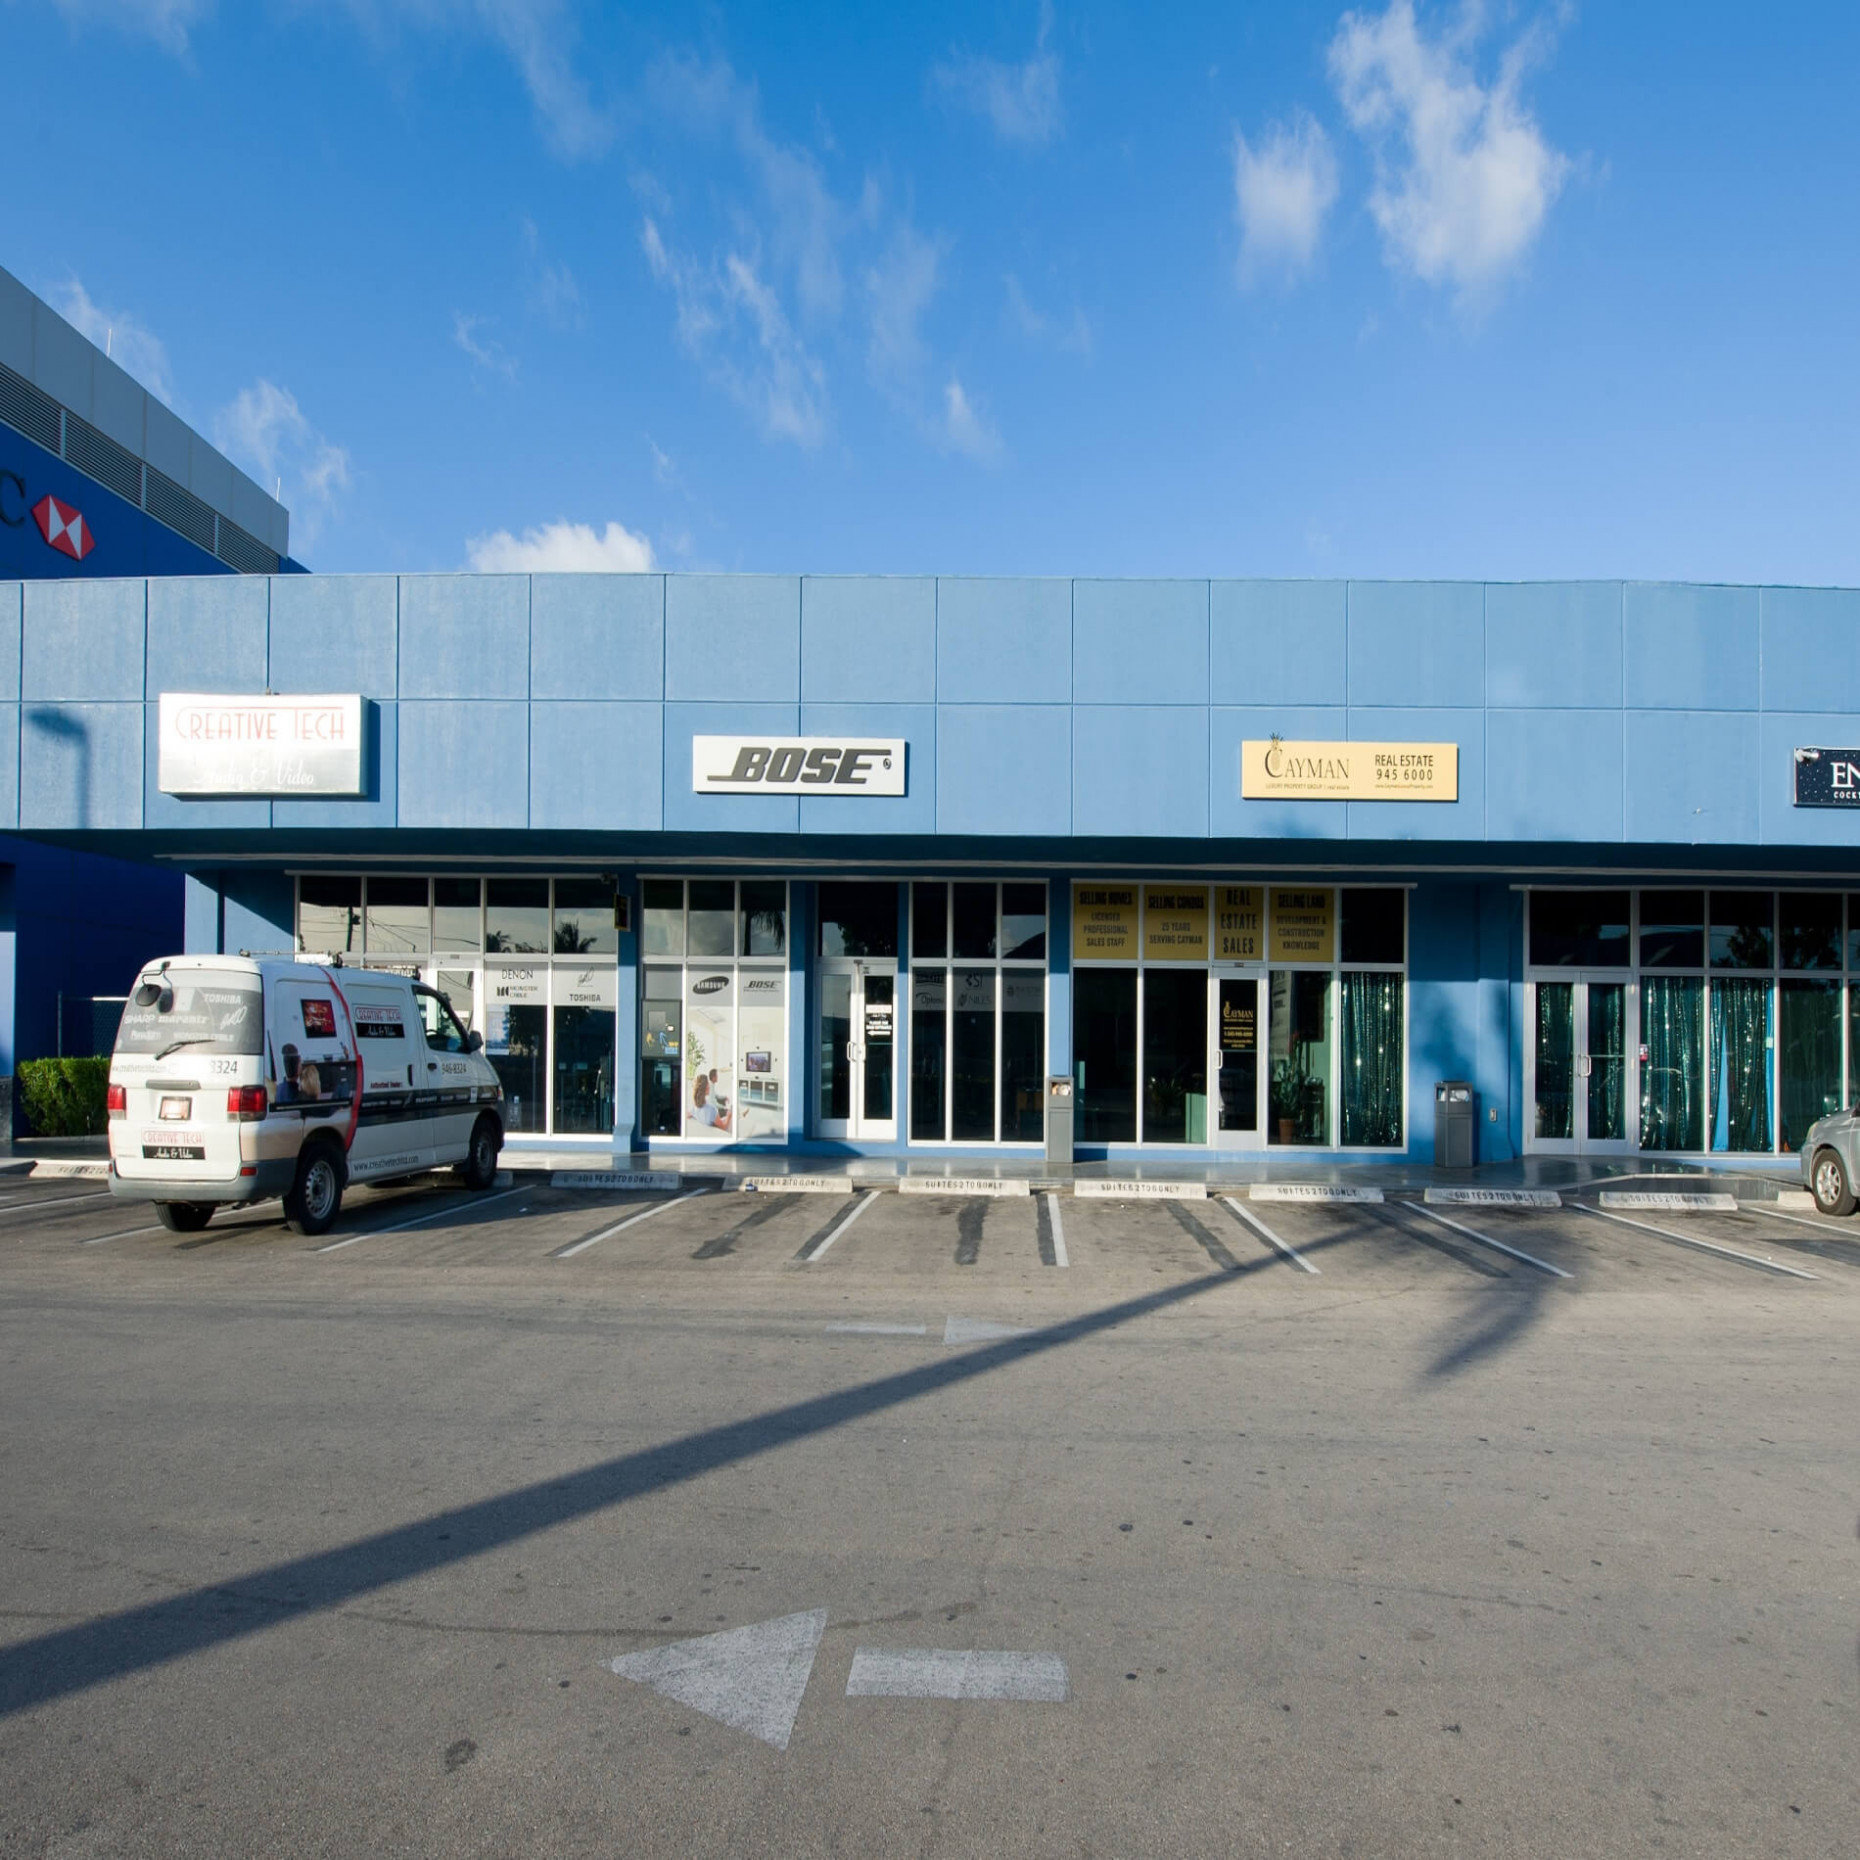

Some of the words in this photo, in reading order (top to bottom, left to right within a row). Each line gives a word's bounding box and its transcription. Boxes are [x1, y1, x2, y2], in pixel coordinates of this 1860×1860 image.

[176, 706, 278, 740] CREATIVE
[293, 706, 344, 740] TECH
[707, 747, 892, 784] BOSE
[1265, 747, 1350, 779] CAYMAN
[1375, 754, 1398, 767] REAL
[1400, 755, 1434, 767] ESTATE
[1376, 768, 1398, 780] 945
[1404, 769, 1433, 781] 6000
[1080, 892, 1107, 905] SELLING
[1148, 895, 1175, 909] SELLING
[1226, 889, 1251, 906] REAL
[1278, 894, 1305, 908] SELLING
[1172, 922, 1191, 931] YEARS
[1221, 913, 1257, 930] ESTATE
[1083, 925, 1128, 934] PROFESSIONAL
[1278, 928, 1325, 937] CONSTRUCTION
[1087, 937, 1105, 947] SALES
[1107, 938, 1125, 947] STAFF
[1149, 935, 1175, 944] SERVING
[1177, 935, 1203, 945] CAYMAN
[1223, 937, 1254, 954] SALES
[1283, 941, 1320, 950] KNOWLEDGE
[501, 968, 533, 980] DENON
[744, 980, 781, 989] BOSE
[205, 993, 242, 1005] TOSHIBA
[569, 993, 601, 1002] TOSHIBA
[1223, 1003, 1254, 1018] CAYMAN
[124, 1014, 156, 1024] SHARP
[158, 1015, 208, 1024] marantz
